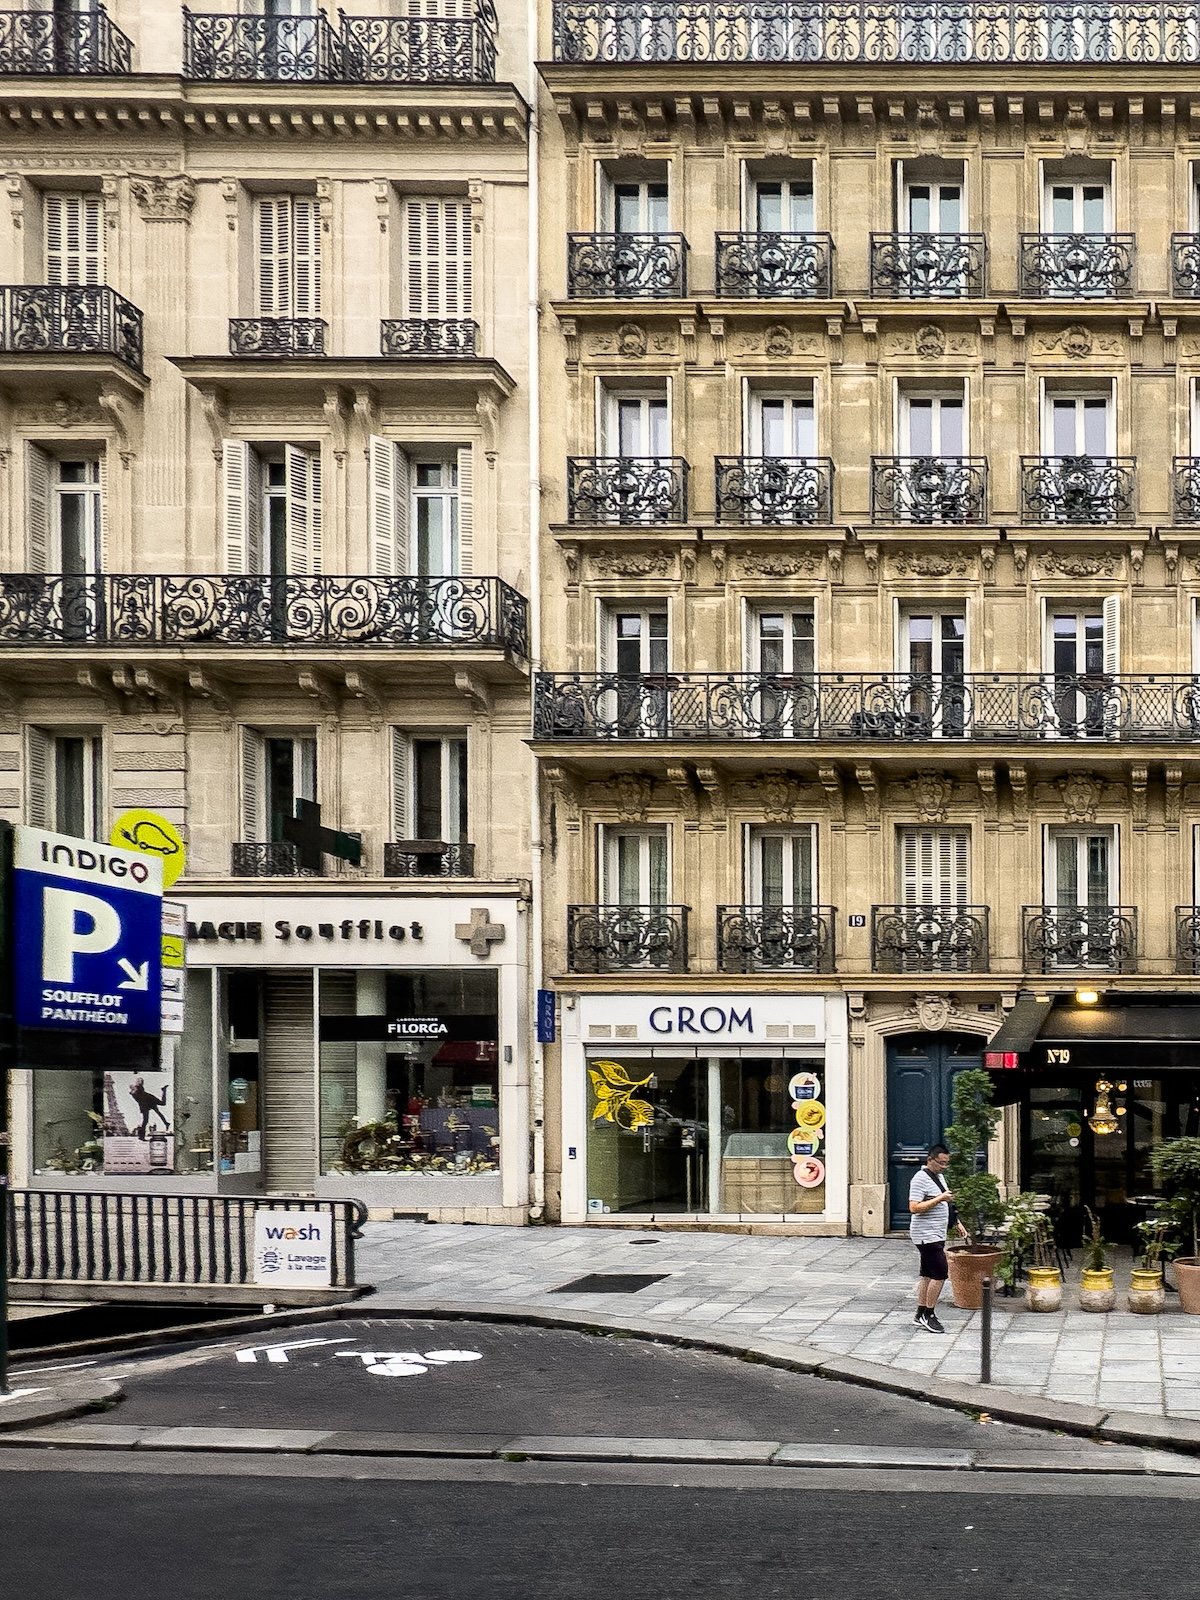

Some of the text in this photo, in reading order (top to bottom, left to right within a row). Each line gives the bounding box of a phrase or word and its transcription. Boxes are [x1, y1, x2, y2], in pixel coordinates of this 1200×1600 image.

[41, 841, 149, 884] INDIGO
[851, 915, 864, 927] 19
[42, 886, 122, 983] P
[274, 919, 424, 941] Soufflot
[42, 989, 123, 1007] SOUFFLOT
[41, 1007, 128, 1024] PANTHÉON
[649, 1006, 754, 1034] GROM
[387, 1023, 448, 1034] FILORGA
[265, 1223, 321, 1240] wash
[287, 1253, 327, 1264] Lavage
